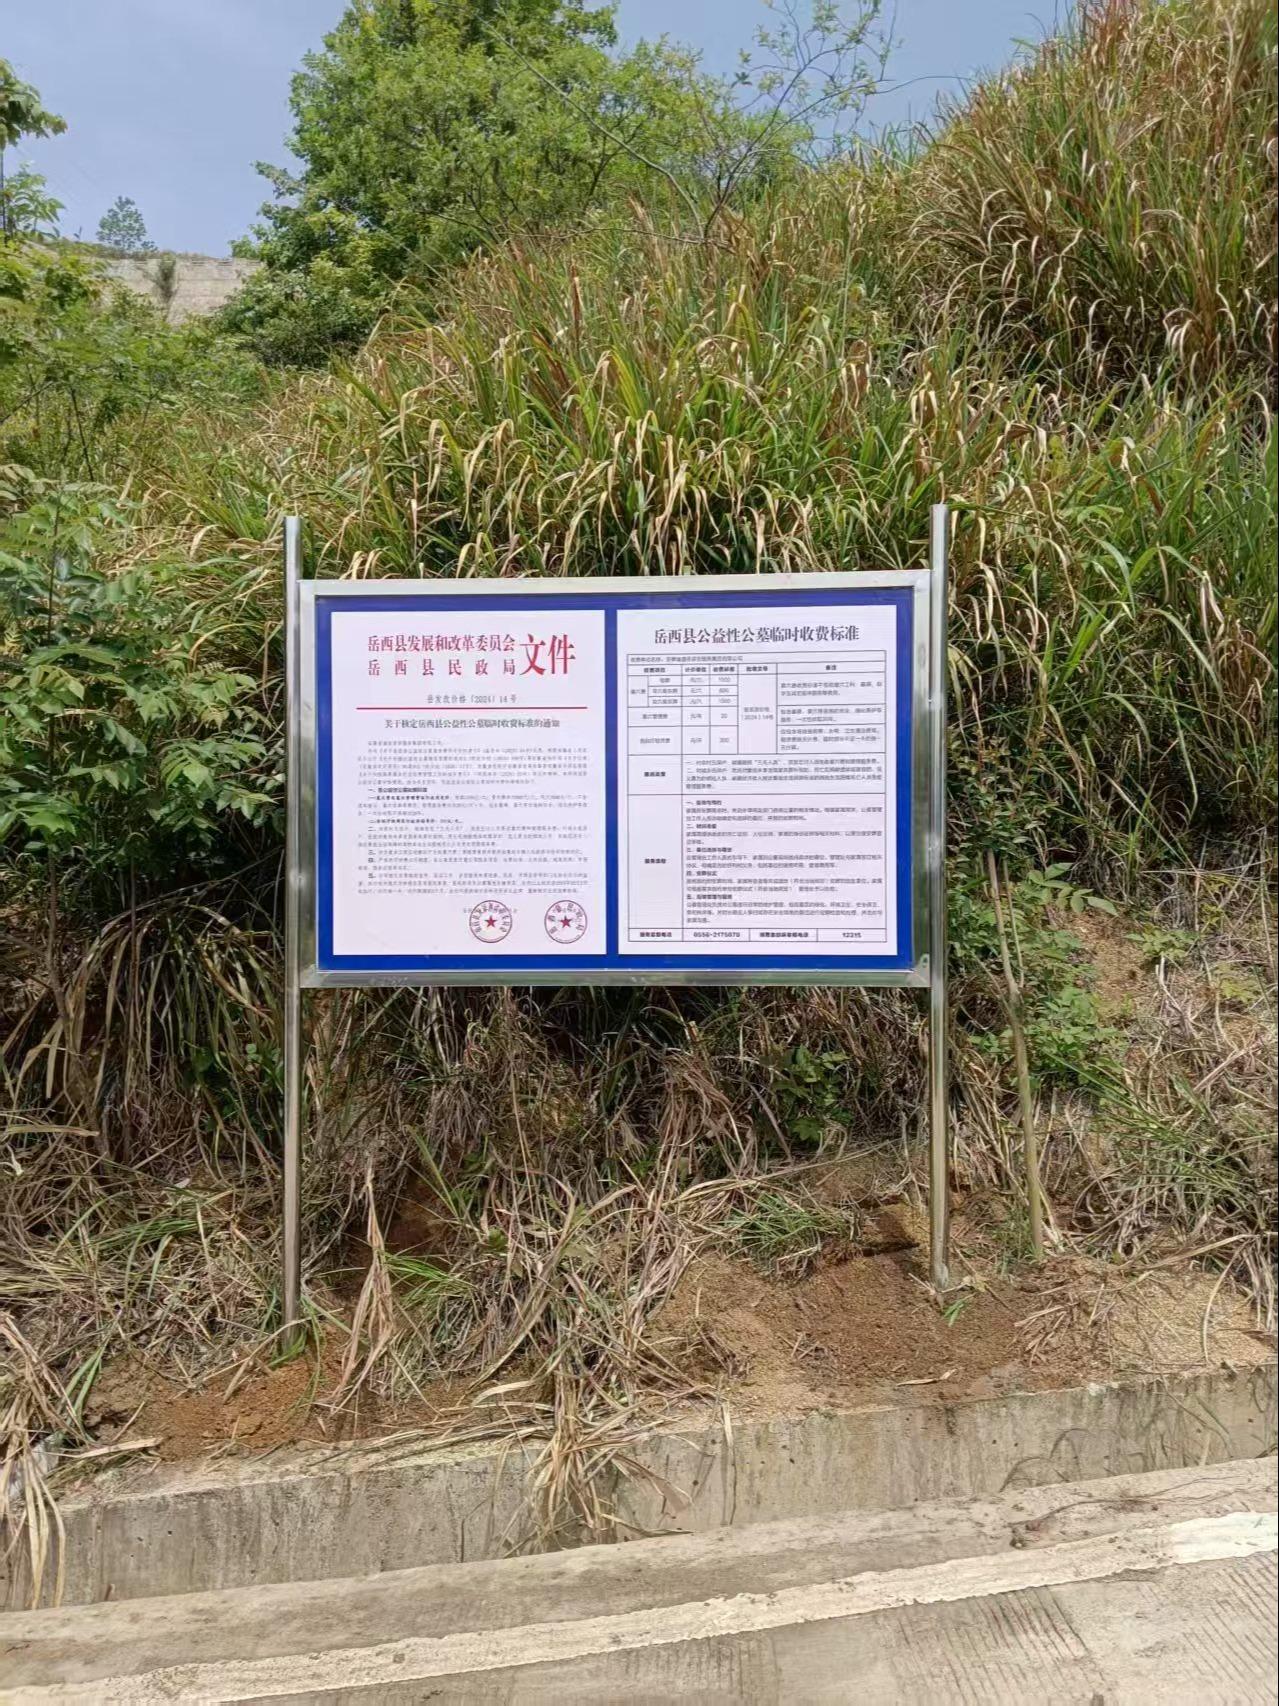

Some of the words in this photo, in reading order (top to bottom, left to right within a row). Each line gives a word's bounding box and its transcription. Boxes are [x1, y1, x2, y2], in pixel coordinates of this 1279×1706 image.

[367, 634, 516, 652] 岳西县发展和改革委员会
[654, 625, 860, 645] 岳西县公益性公墓临时收费标准
[519, 633, 576, 676] 文件
[367, 658, 516, 676] 岳西县民政局
